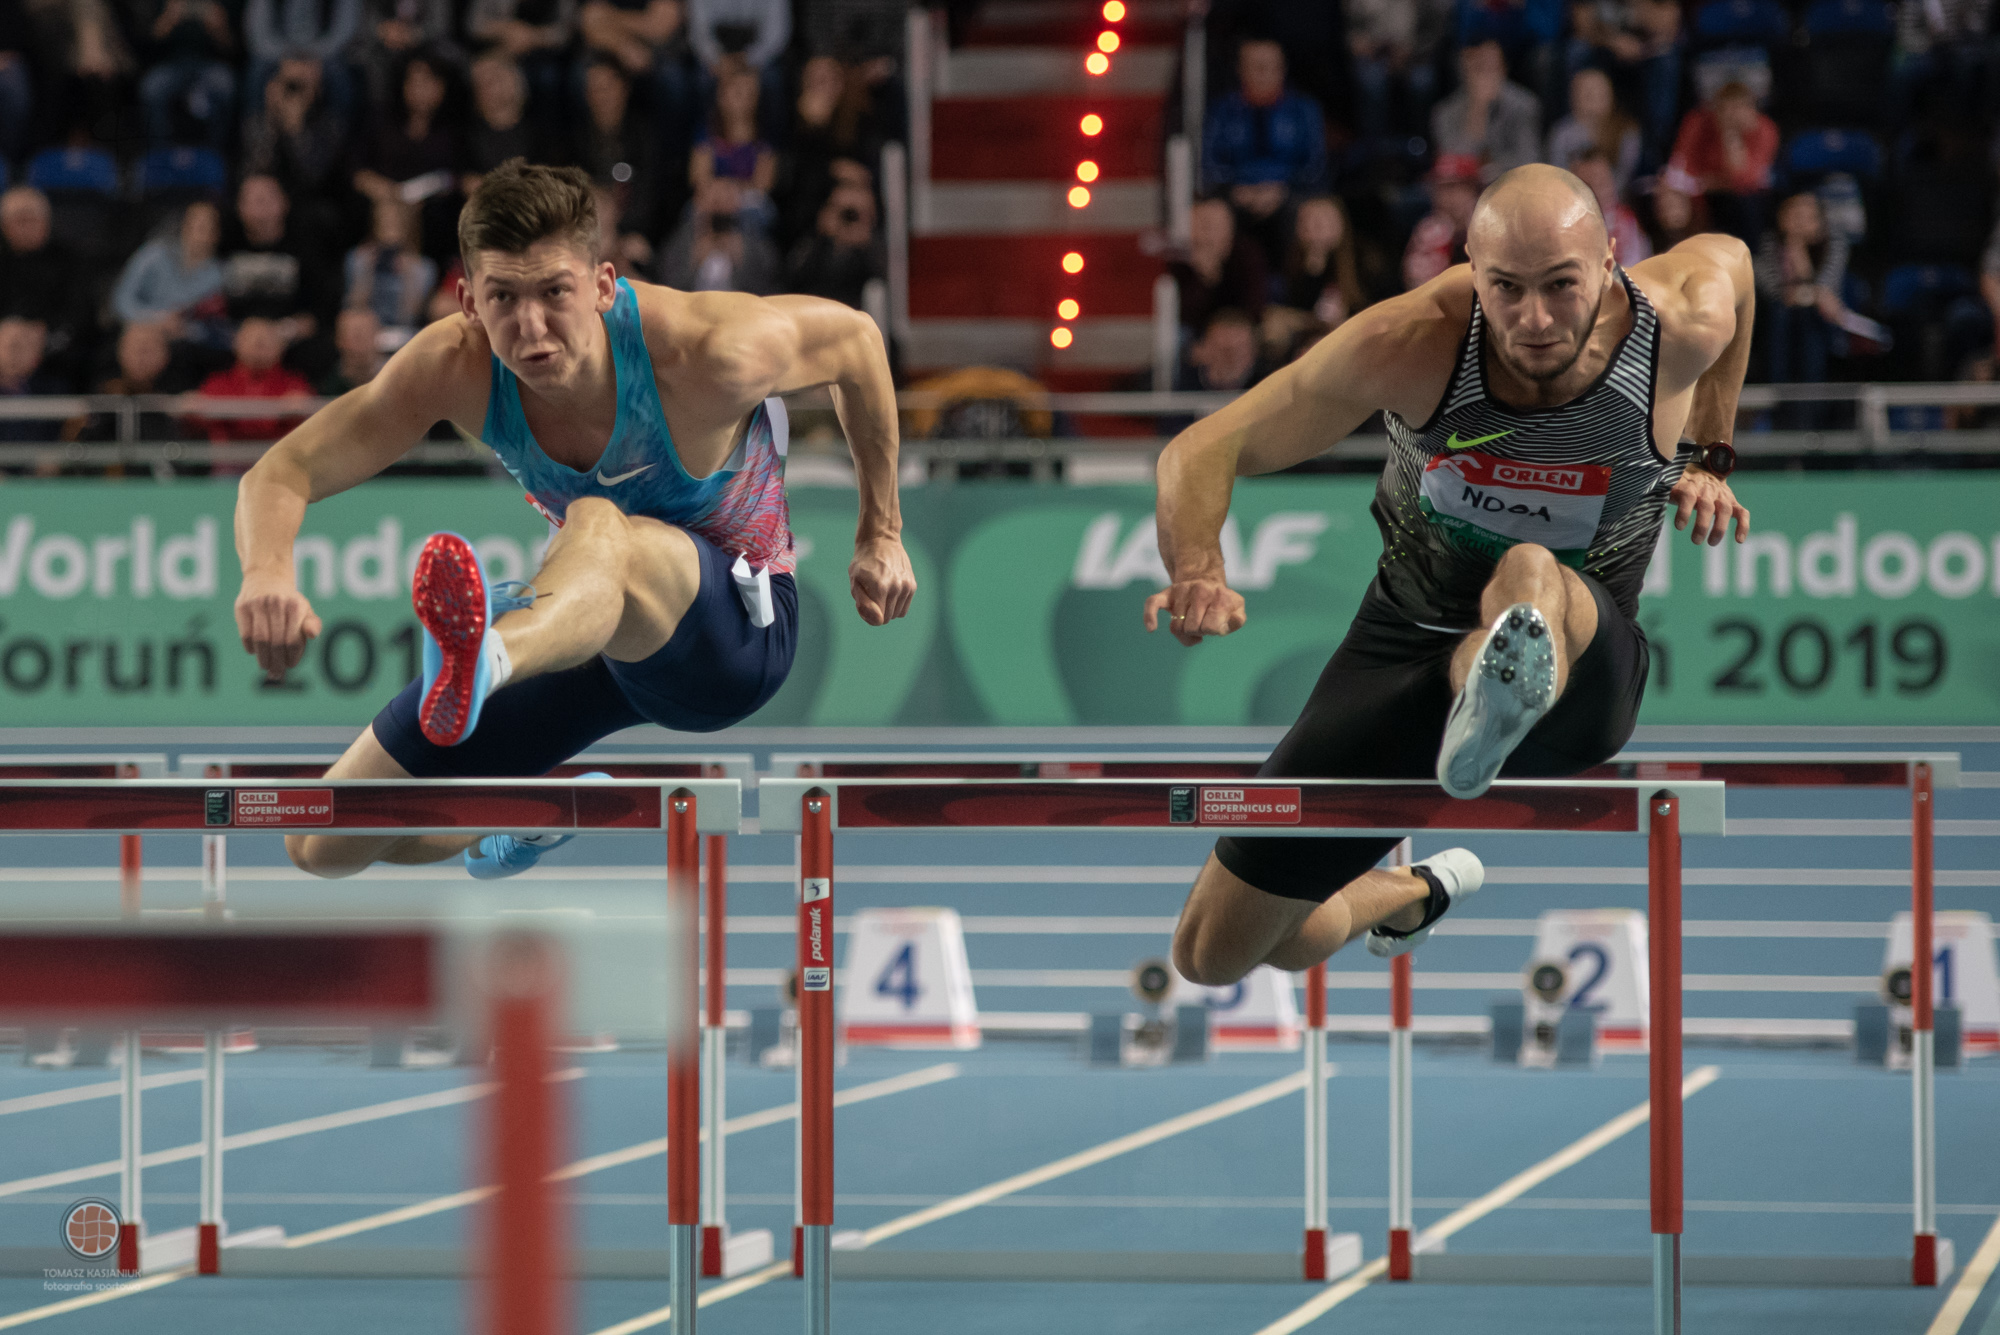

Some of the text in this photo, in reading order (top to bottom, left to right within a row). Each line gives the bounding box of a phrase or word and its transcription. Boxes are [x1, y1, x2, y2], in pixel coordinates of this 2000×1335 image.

[1498, 467, 1578, 488] ORLEN
[1703, 513, 2000, 598] Indoo
[0, 612, 216, 695] oruń
[1709, 613, 1949, 698] 2019
[241, 794, 275, 803] ORLEN
[1206, 791, 1241, 800] ORLEN
[239, 806, 329, 815] COPERNICUS CUP
[265, 815, 282, 823] 2019
[1204, 804, 1297, 813] COPERNICUS CUP
[809, 907, 825, 961] polanik
[807, 973, 827, 981] IAAF
[874, 940, 922, 1010] 4
[1567, 942, 1612, 1012] 2
